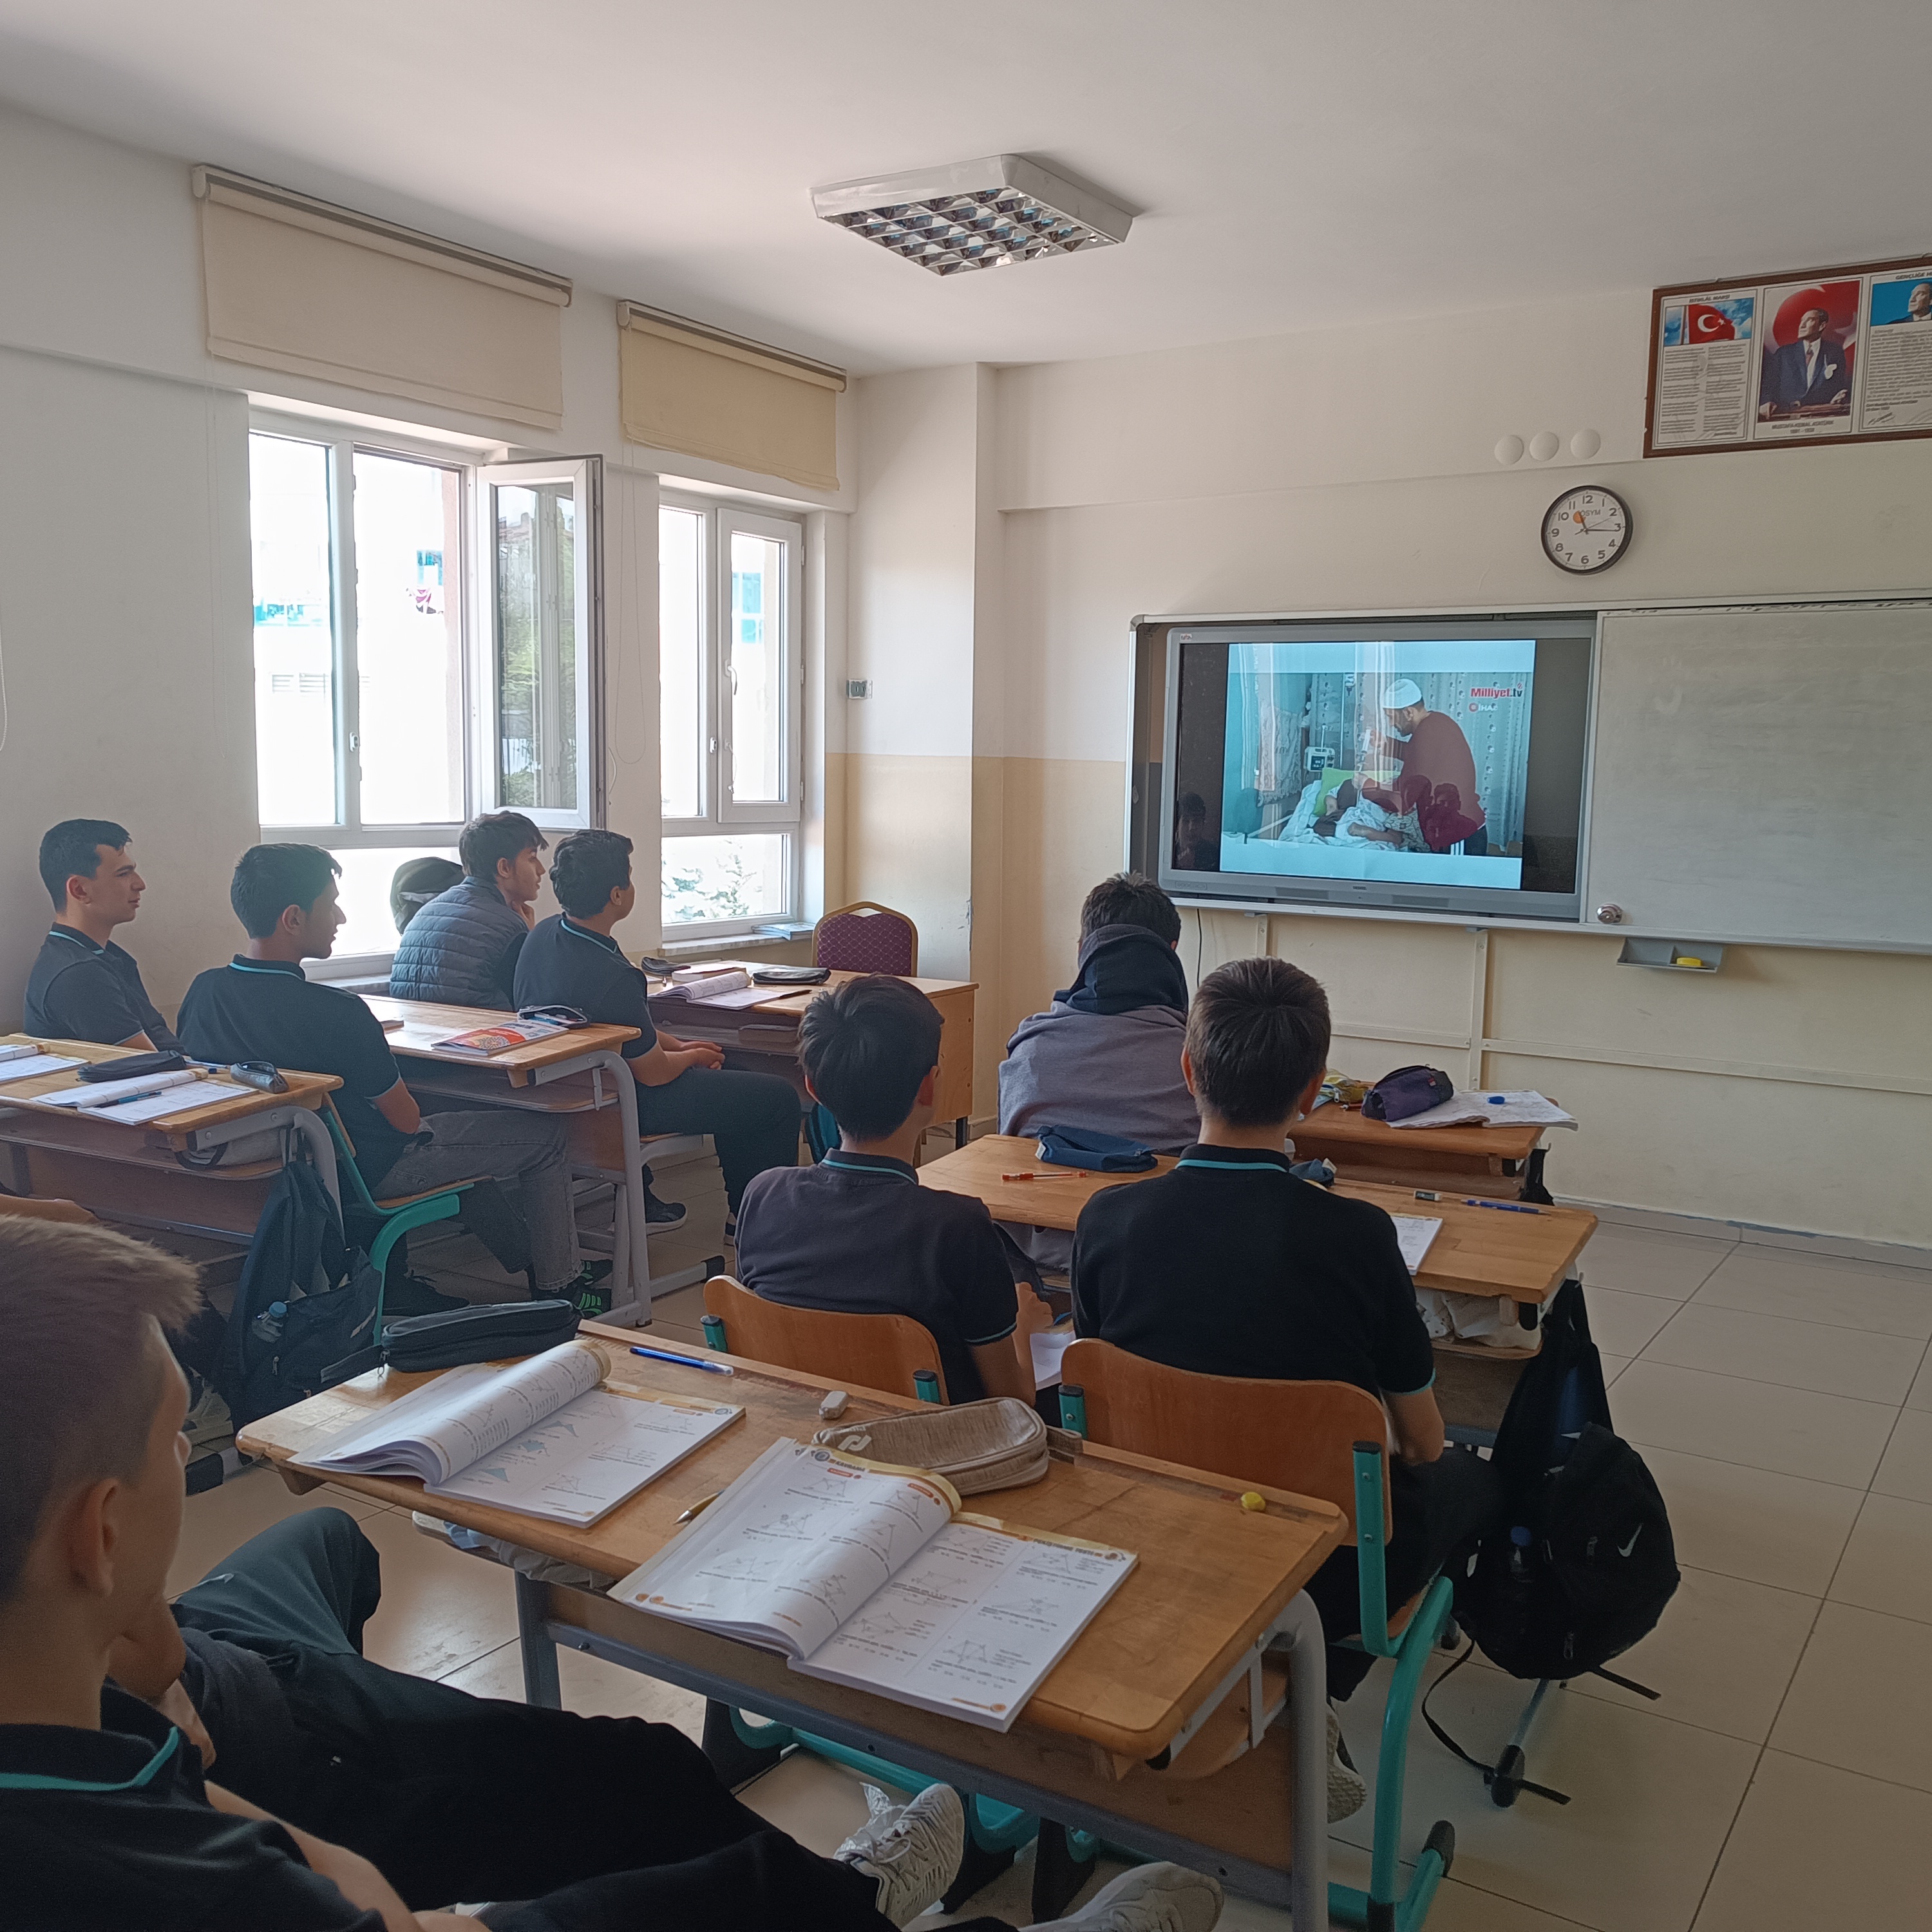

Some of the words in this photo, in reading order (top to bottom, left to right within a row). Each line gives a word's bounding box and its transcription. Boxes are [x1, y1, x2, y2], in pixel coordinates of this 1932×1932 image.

[1582, 495, 1593, 504] 12
[1602, 498, 1605, 507] 1
[1569, 500, 1576, 510] 11
[1558, 511, 1569, 521] 10
[1609, 507, 1617, 516] 2
[1614, 523, 1622, 532] 3
[1551, 528, 1560, 537] 9
[1555, 542, 1564, 552] 8
[1608, 538, 1616, 547] 4
[1565, 553, 1573, 562] 7
[1598, 550, 1605, 559] 5
[1580, 555, 1589, 564] 6
